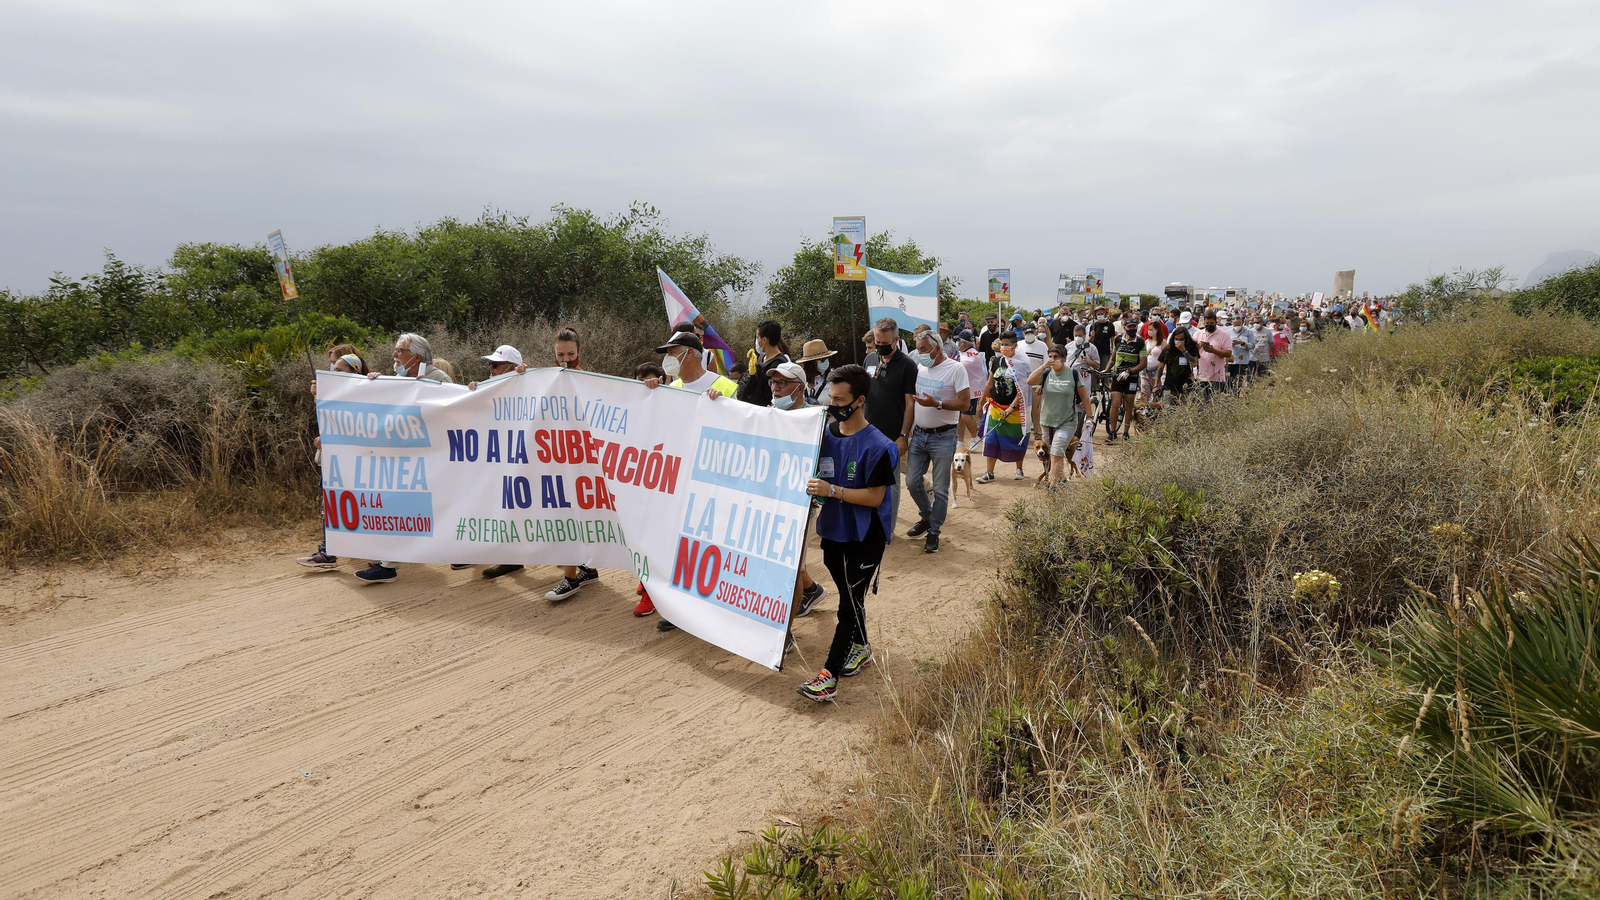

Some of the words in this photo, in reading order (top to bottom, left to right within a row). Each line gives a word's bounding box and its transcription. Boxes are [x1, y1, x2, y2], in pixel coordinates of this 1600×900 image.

[492, 396, 537, 422] UNIDAD
[541, 395, 569, 421] POR
[384, 413, 426, 440] POR
[447, 429, 479, 462] NO
[487, 429, 501, 463] A
[507, 429, 529, 464] LA
[354, 451, 428, 491] LÍNEA
[698, 437, 770, 484] UNIDAD
[775, 452, 813, 493] POR
[322, 488, 360, 530] NO
[360, 492, 367, 508] A
[370, 493, 383, 508] LA
[502, 475, 532, 510] NO
[541, 475, 572, 510] AL
[362, 512, 432, 533] SUBESTACIÓN
[456, 517, 521, 543] #SIERRA
[524, 518, 617, 543] CARBONERA
[681, 492, 715, 541] LA
[723, 499, 799, 567] LÍNEA
[673, 536, 722, 596] NO
[723, 554, 731, 571] A
[734, 554, 747, 577] LA
[716, 580, 788, 625] SUBESTACIÓN
